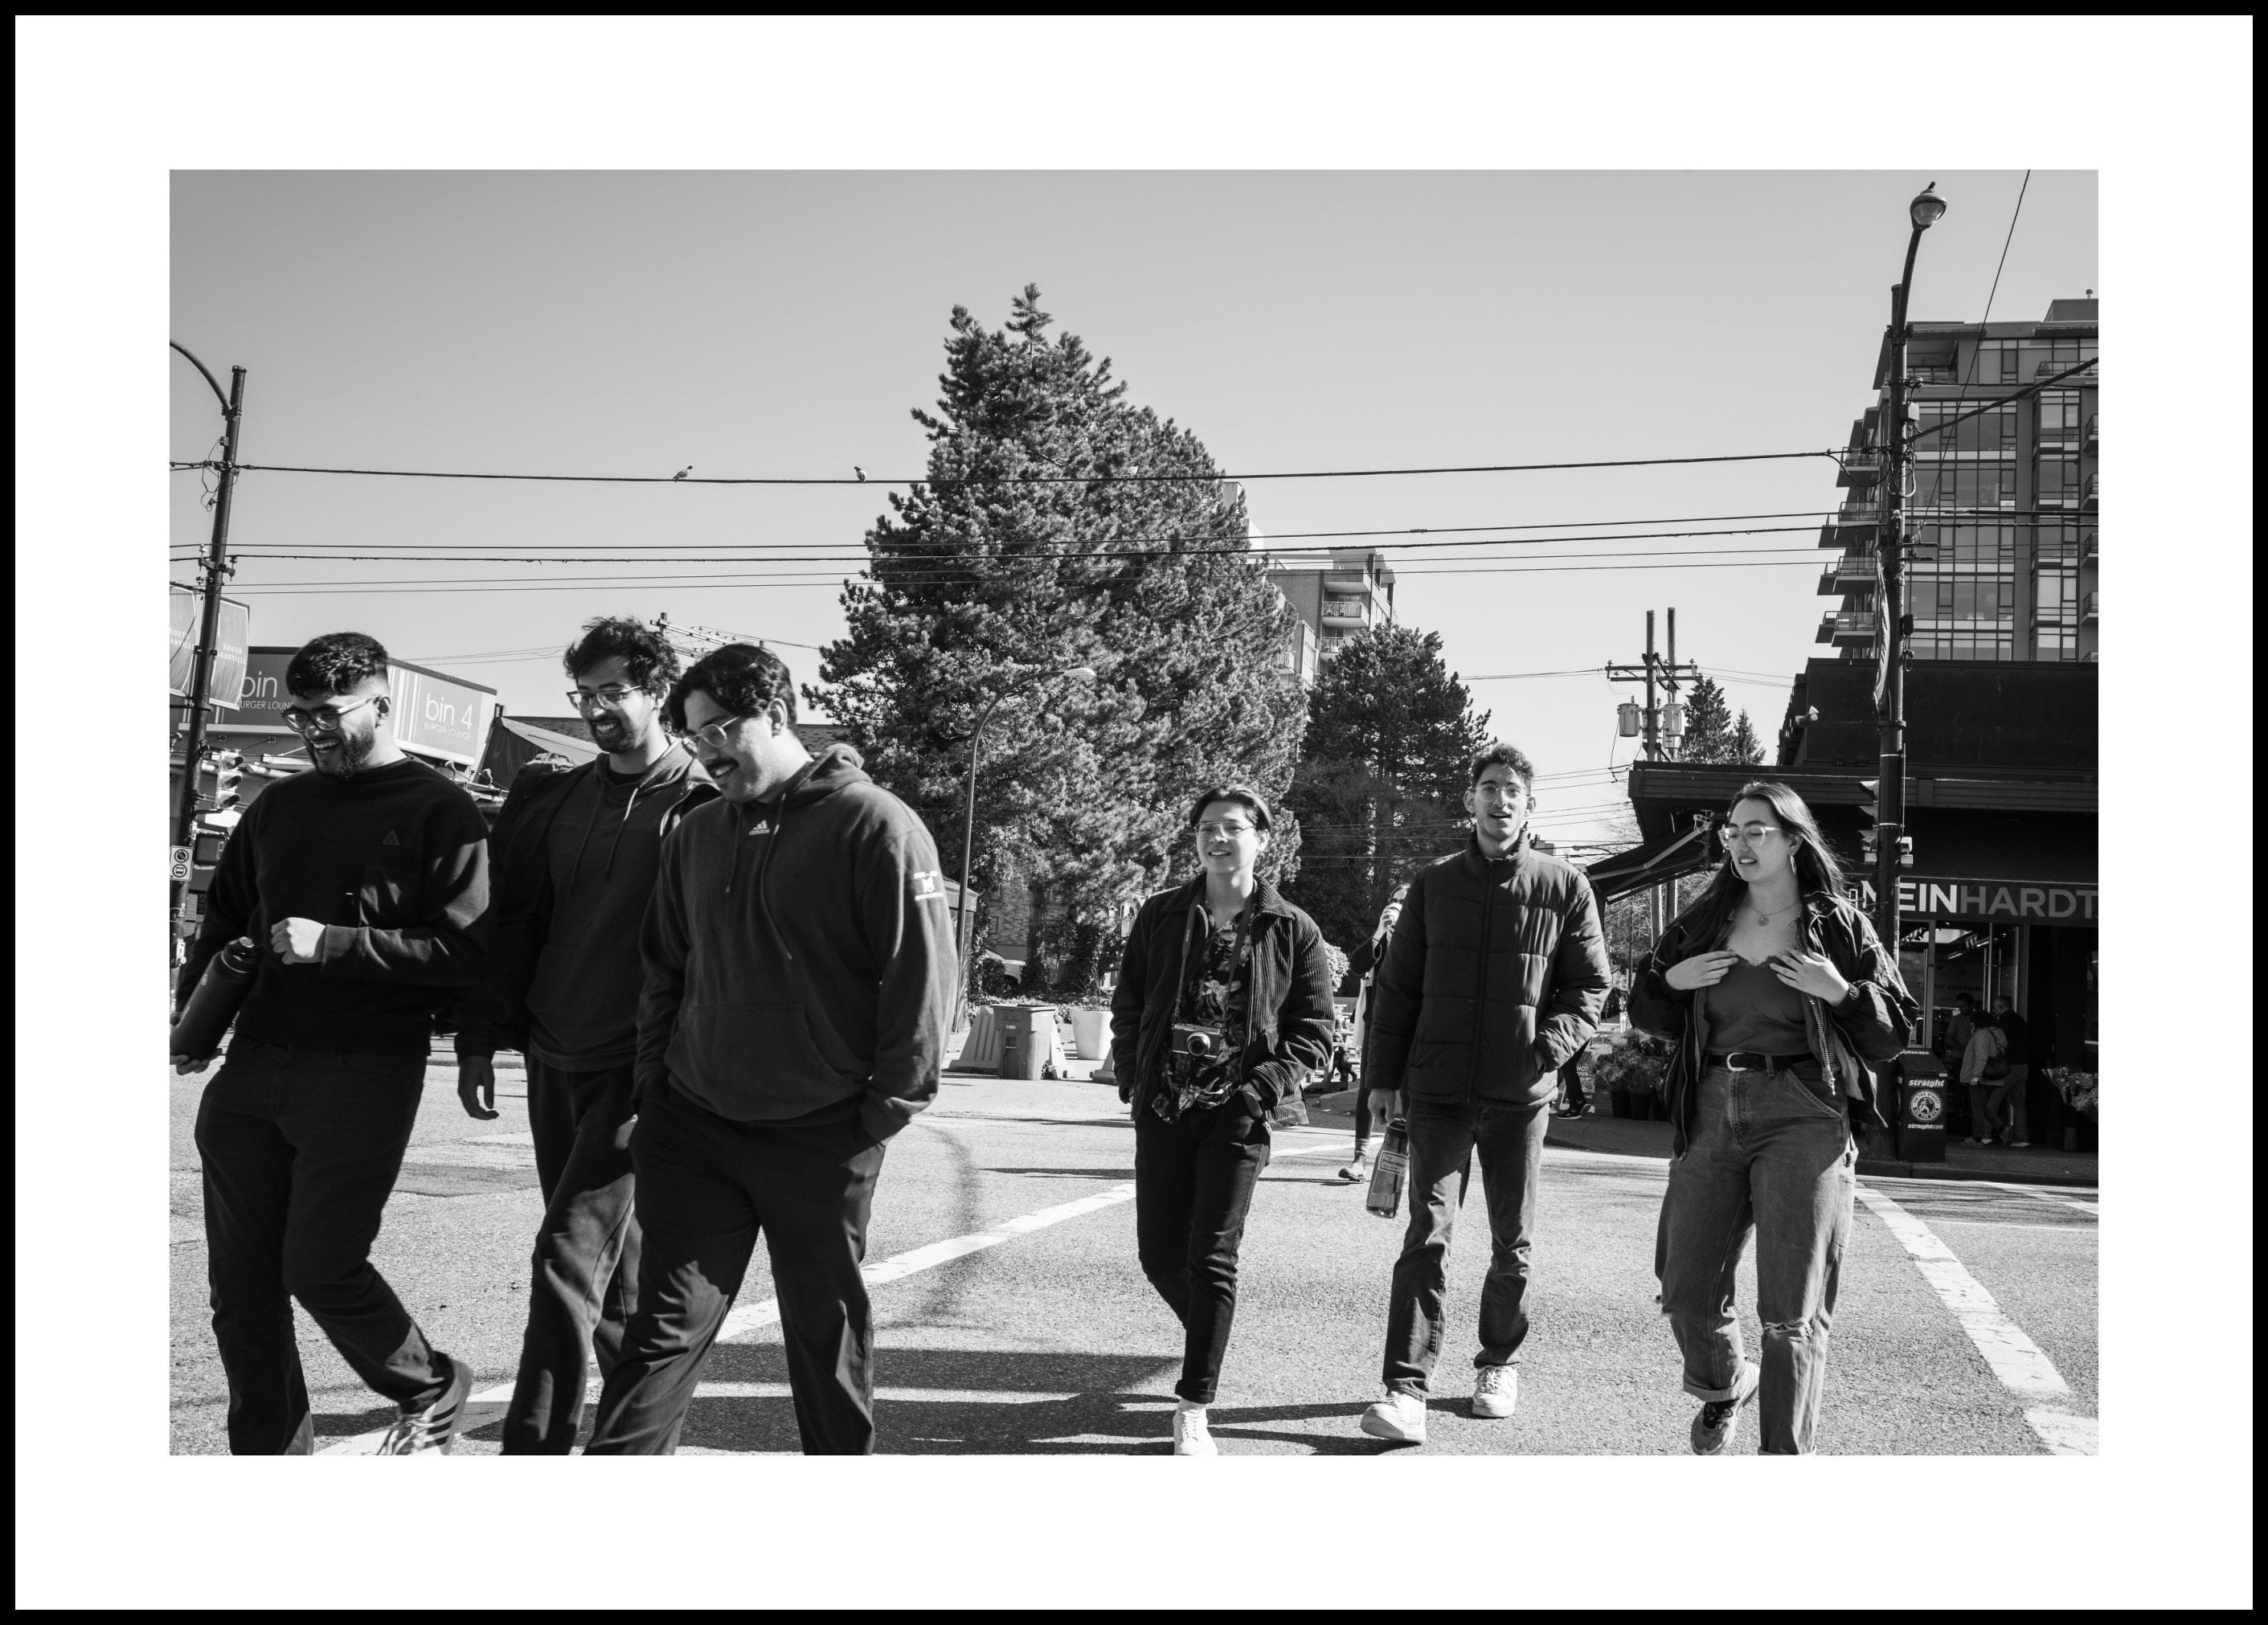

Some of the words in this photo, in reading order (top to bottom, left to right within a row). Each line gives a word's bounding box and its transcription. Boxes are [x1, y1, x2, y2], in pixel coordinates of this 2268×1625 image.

[170, 637, 194, 650] ANVILLE
[222, 643, 243, 655] SOUTH
[240, 670, 278, 698] bin
[240, 700, 267, 709] URGER
[268, 701, 294, 710] LOUN
[425, 692, 455, 726] bin
[461, 704, 473, 730] 4
[424, 721, 447, 735] BURGER
[447, 727, 471, 741] LOUNGE
[1908, 1079, 1945, 1087] straight
[1382, 1158, 1405, 1169] Princeton
